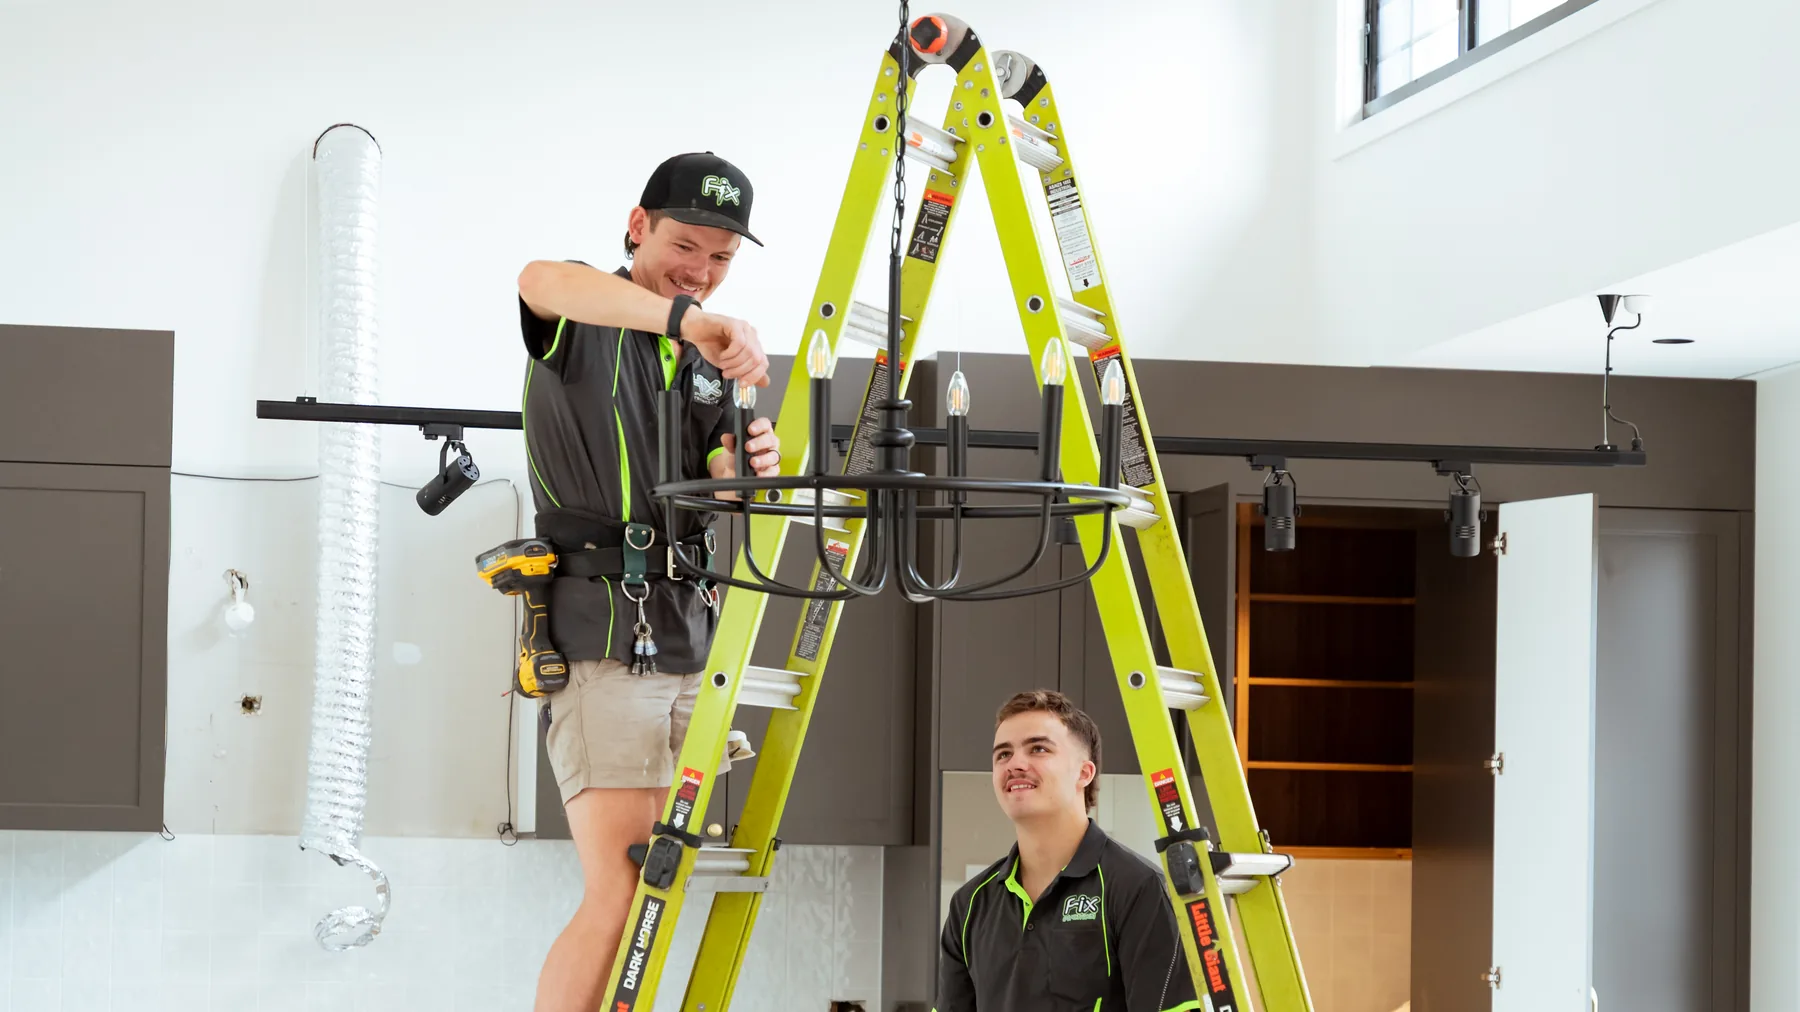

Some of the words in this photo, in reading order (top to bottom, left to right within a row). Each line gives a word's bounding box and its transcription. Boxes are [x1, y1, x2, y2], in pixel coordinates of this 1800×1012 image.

[623, 949, 645, 990] DARK
[636, 899, 660, 949] HORSE
[1191, 901, 1212, 947] Little
[1204, 949, 1227, 993] Giant
